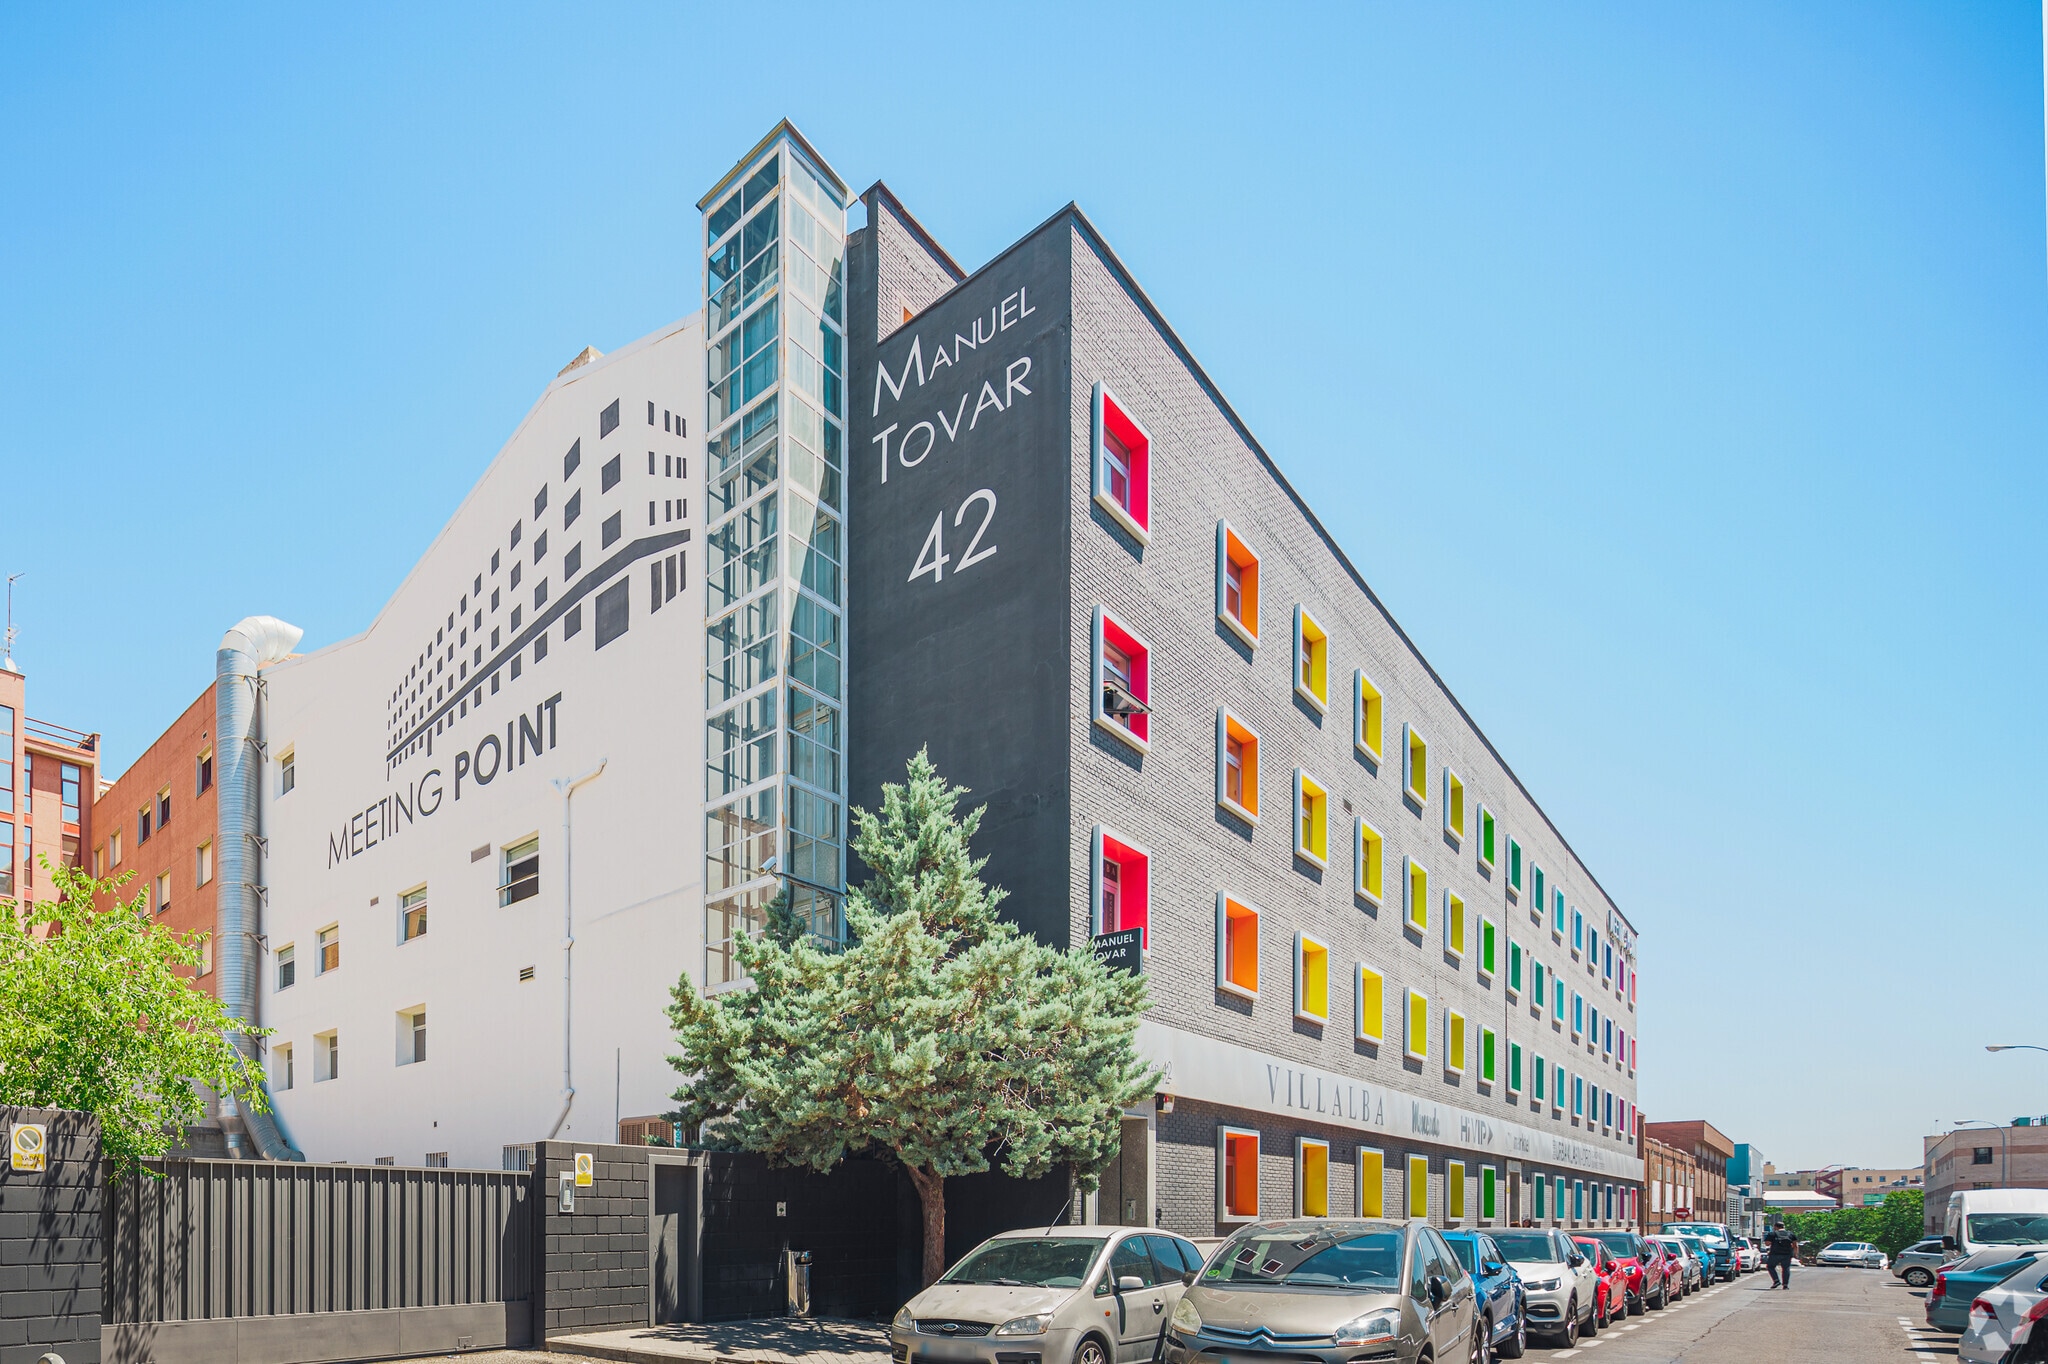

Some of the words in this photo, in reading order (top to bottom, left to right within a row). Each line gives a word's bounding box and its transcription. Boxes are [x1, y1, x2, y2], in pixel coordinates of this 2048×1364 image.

[872, 286, 1036, 417] MANUEL
[872, 356, 1032, 485] TOVAR
[907, 488, 997, 583] 42
[328, 768, 442, 869] MEETING
[454, 691, 562, 801] POINT
[1091, 933, 1135, 949] MANUEL
[1266, 1063, 1384, 1126] VILLALBA
